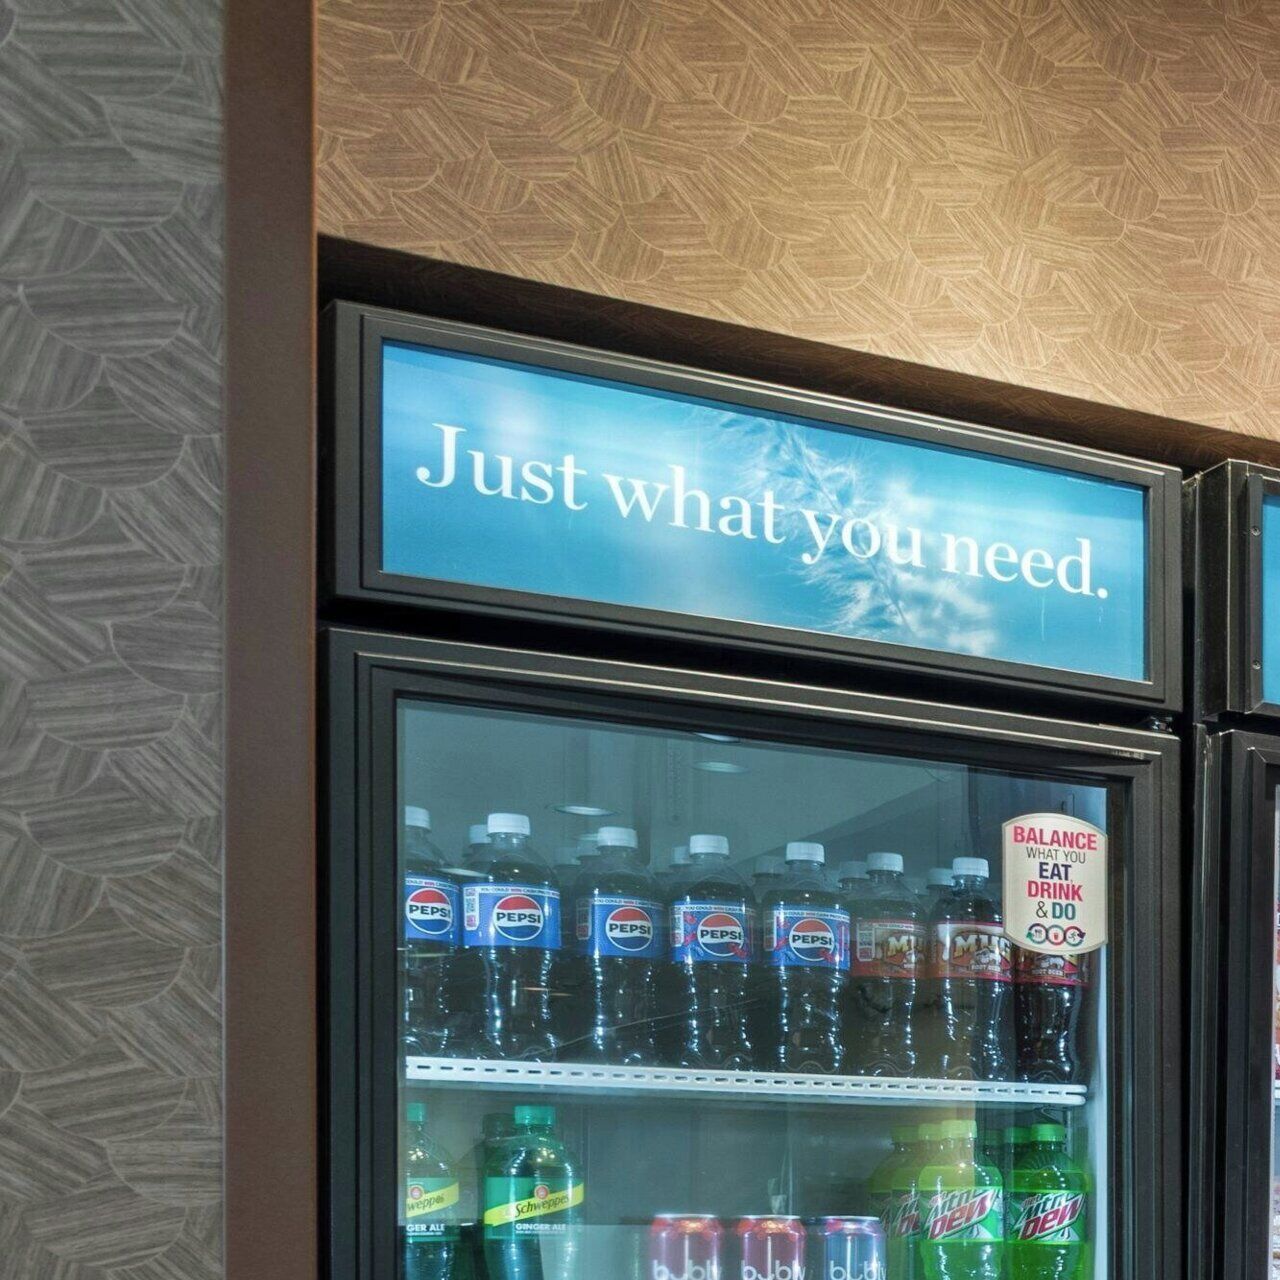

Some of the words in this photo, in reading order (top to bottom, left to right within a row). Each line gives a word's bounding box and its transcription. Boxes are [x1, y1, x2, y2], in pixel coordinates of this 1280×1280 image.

[416, 423, 588, 511] Just
[600, 464, 784, 544] what
[801, 508, 922, 566] you
[946, 537, 1108, 599] need.
[1013, 826, 1097, 850] BALANCE
[1027, 847, 1058, 860] WHAT
[1063, 851, 1086, 863] YOU
[1028, 880, 1083, 901] DRINK
[409, 904, 450, 918] PEPSI
[496, 912, 541, 924] PEPSI
[1036, 901, 1048, 918] &
[1052, 902, 1076, 920] DO
[609, 923, 651, 934] PEPSI
[700, 930, 742, 941] PEPSI
[792, 934, 833, 945] PEPSI
[515, 1193, 570, 1216] Schweppes
